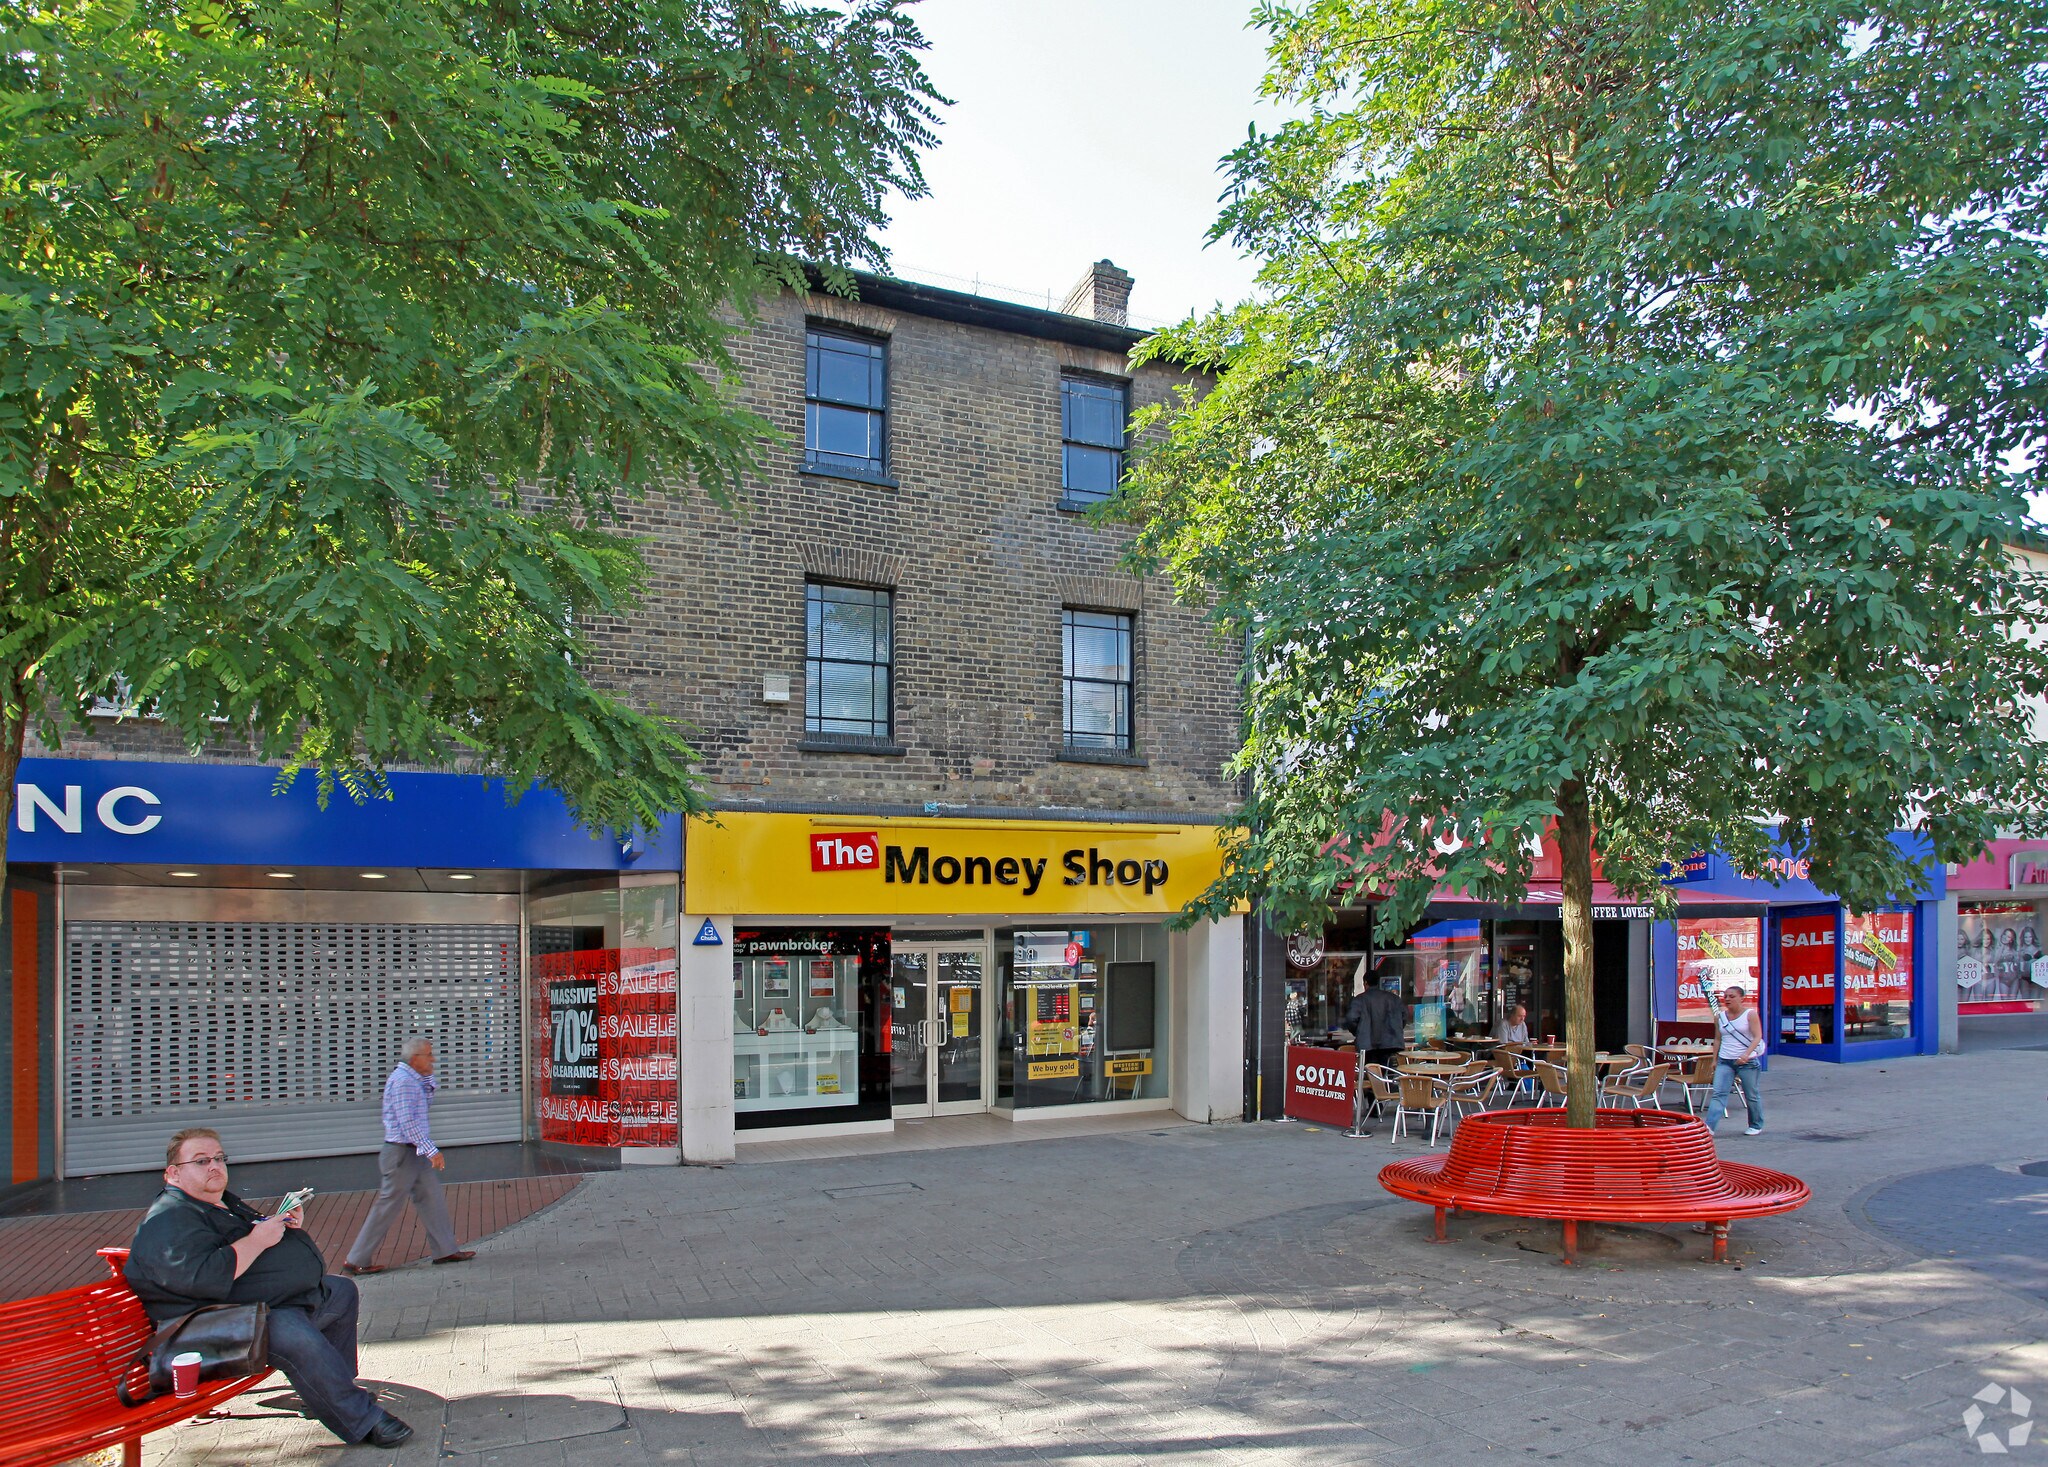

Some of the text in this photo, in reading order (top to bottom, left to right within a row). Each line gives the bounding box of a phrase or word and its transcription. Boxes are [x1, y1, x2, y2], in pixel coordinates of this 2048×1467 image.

[17, 784, 163, 835] NC
[816, 839, 1169, 896] The Money Shop
[1721, 934, 1755, 948] SALE
[1782, 931, 1834, 947] SALE
[1879, 930, 1908, 942] SALE
[750, 939, 834, 954] pawnbroker
[1291, 949, 1321, 965] COFFEE
[1783, 974, 1834, 990] SALE
[1844, 972, 1907, 989] SALE SALE
[1957, 970, 1977, 979] £30
[551, 986, 597, 1005] MASSIVE
[551, 1009, 598, 1063] 70%
[581, 1043, 598, 1057] OFF
[552, 1065, 599, 1078] CLEARANCE
[1045, 1064, 1058, 1073] buy
[1060, 1062, 1075, 1073] gold
[1296, 1064, 1346, 1088] COSTA
[1295, 1085, 1346, 1101] FOR COFFEE LOVERS
[542, 1097, 568, 1121] SALE
[569, 1098, 609, 1123] SALE
